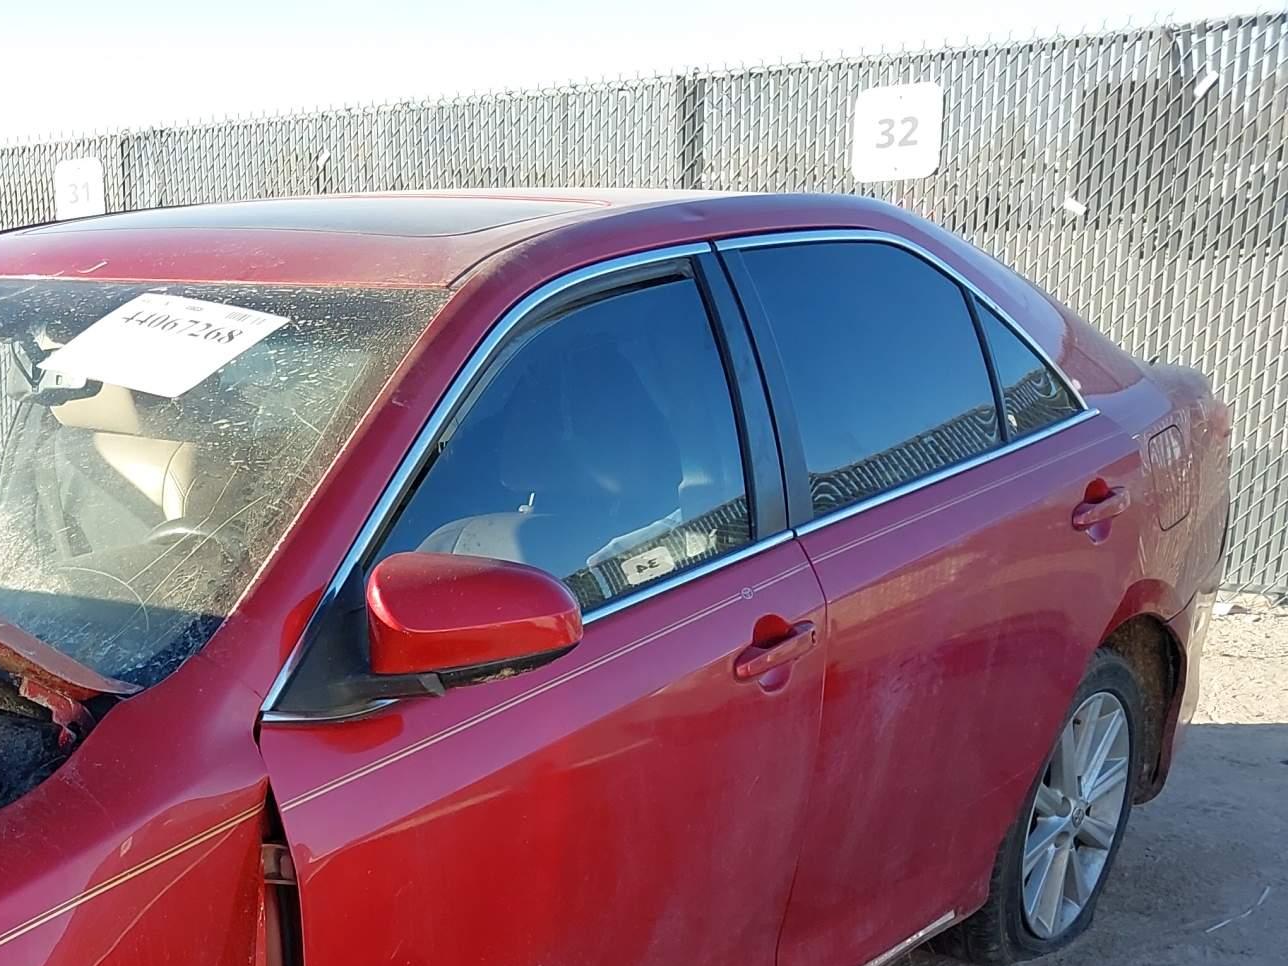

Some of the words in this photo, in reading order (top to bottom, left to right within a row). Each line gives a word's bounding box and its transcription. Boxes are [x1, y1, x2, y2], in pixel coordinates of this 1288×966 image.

[875, 116, 919, 149] 32
[68, 181, 91, 205] 31
[121, 310, 243, 344] 44067268
